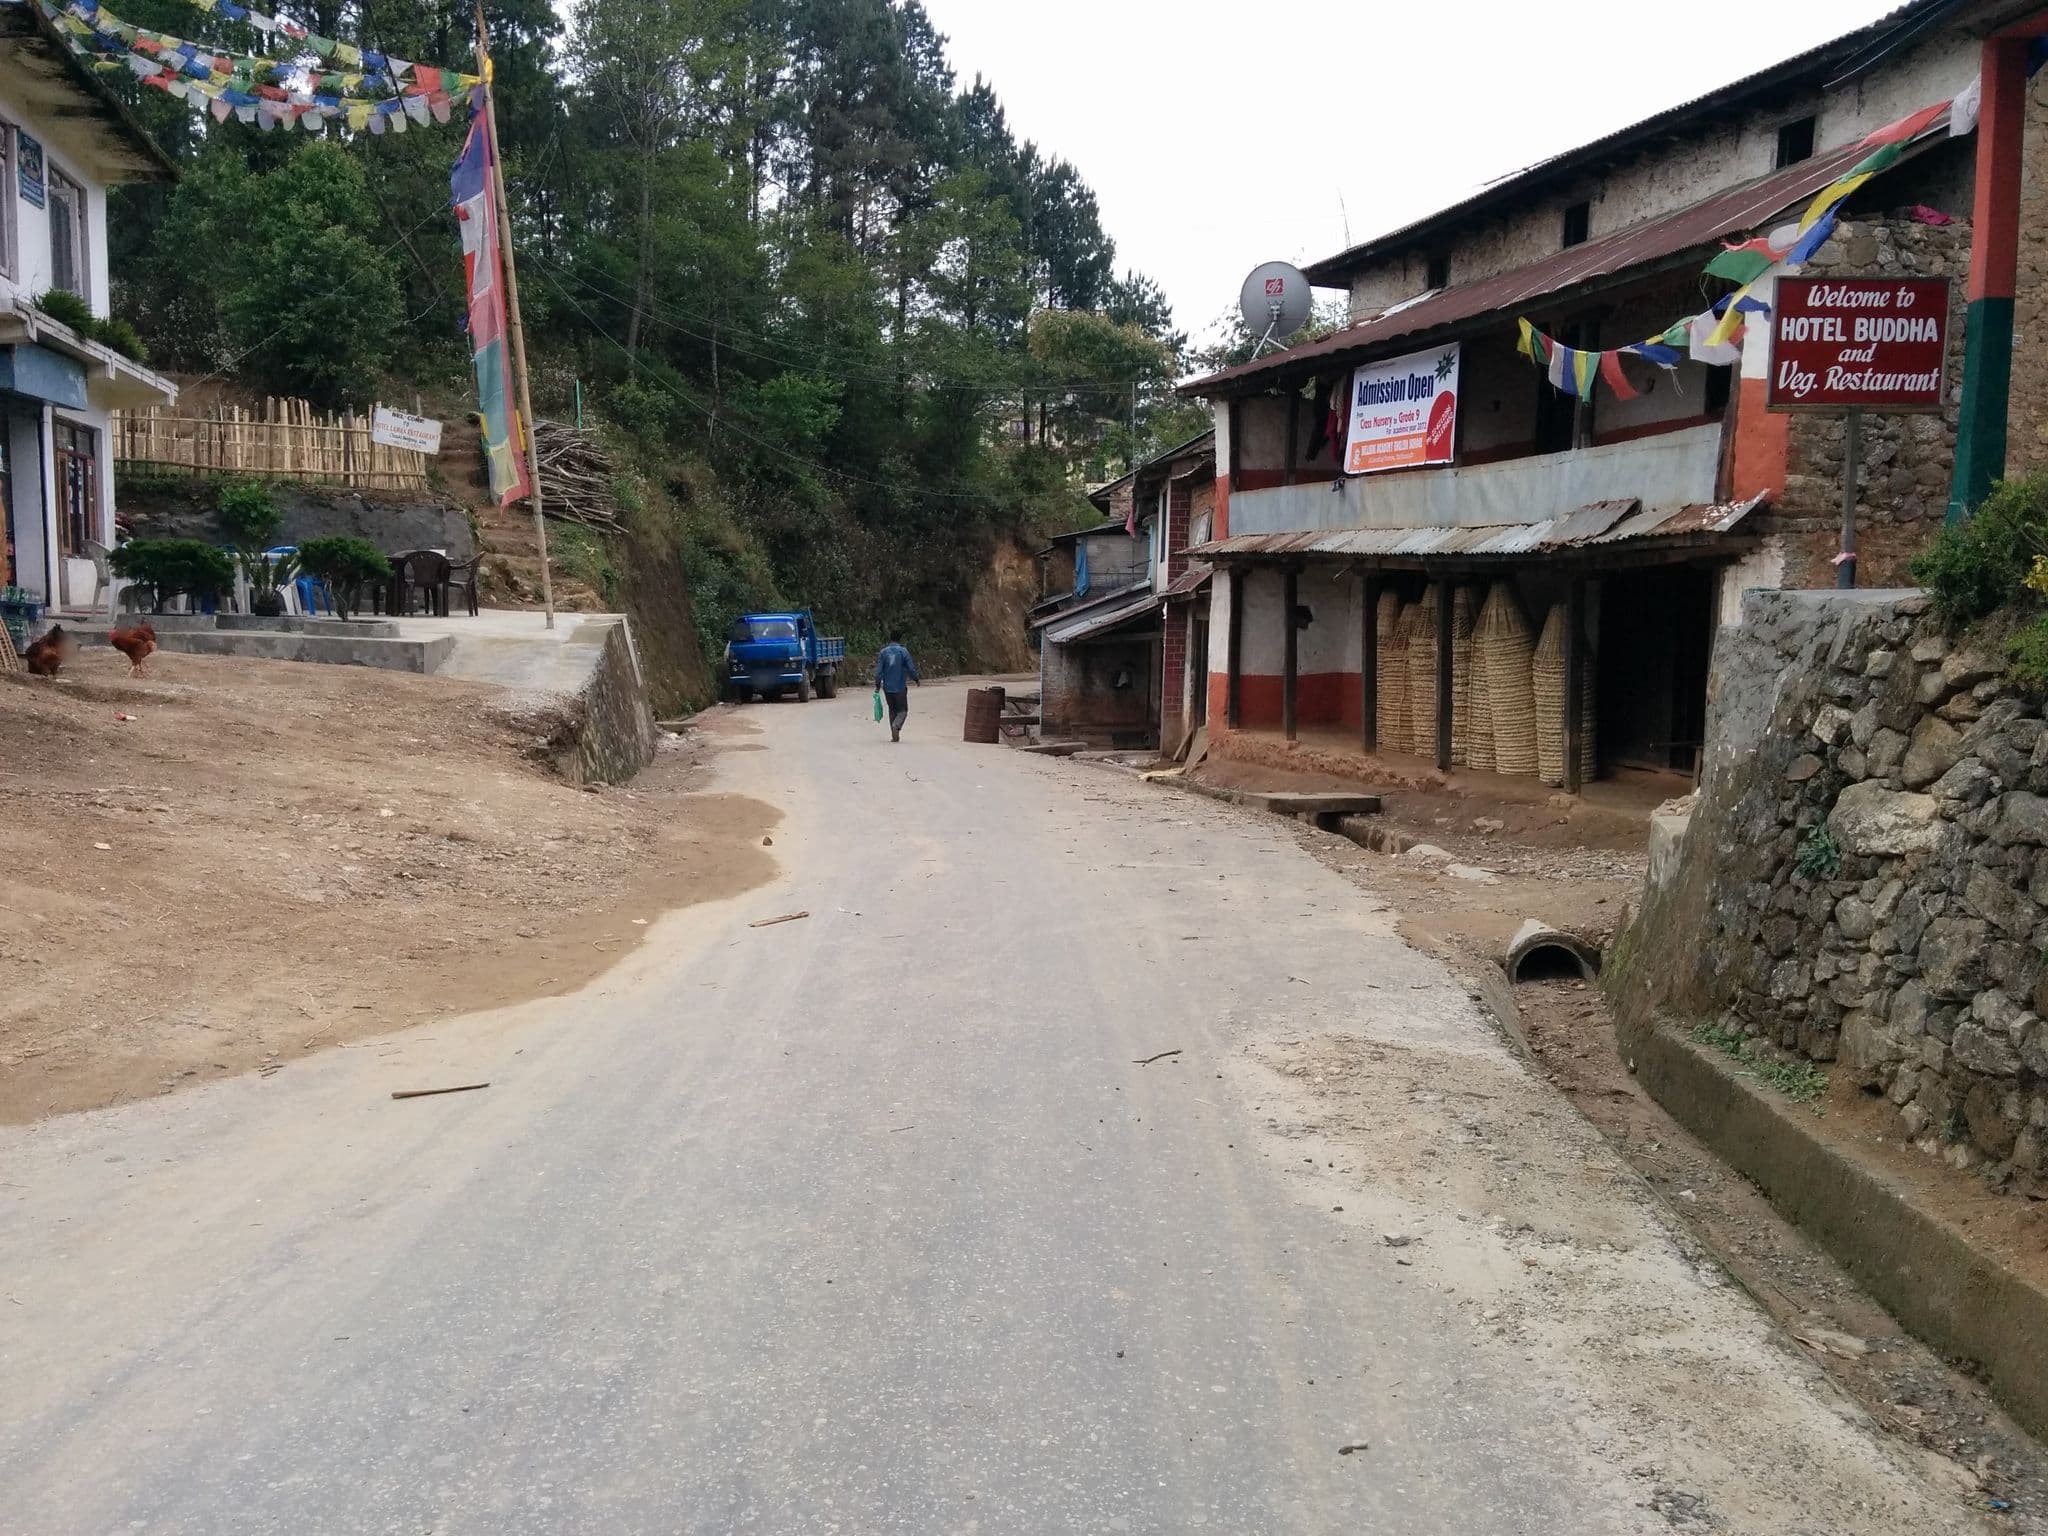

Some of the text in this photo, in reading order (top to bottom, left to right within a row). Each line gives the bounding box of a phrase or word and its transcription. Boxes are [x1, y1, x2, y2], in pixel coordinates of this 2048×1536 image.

[1807, 285, 1915, 308] Welcome to
[1781, 317, 1938, 342] HOTEL BUDDHA
[1838, 342, 1877, 362] and
[1357, 372, 1434, 407] Admission Open
[1778, 360, 1940, 398] Veg. Restaurant
[1360, 419, 1372, 429] Class
[1373, 416, 1392, 428] Nursery
[1399, 411, 1415, 423] Grade
[1416, 409, 1421, 420] 9
